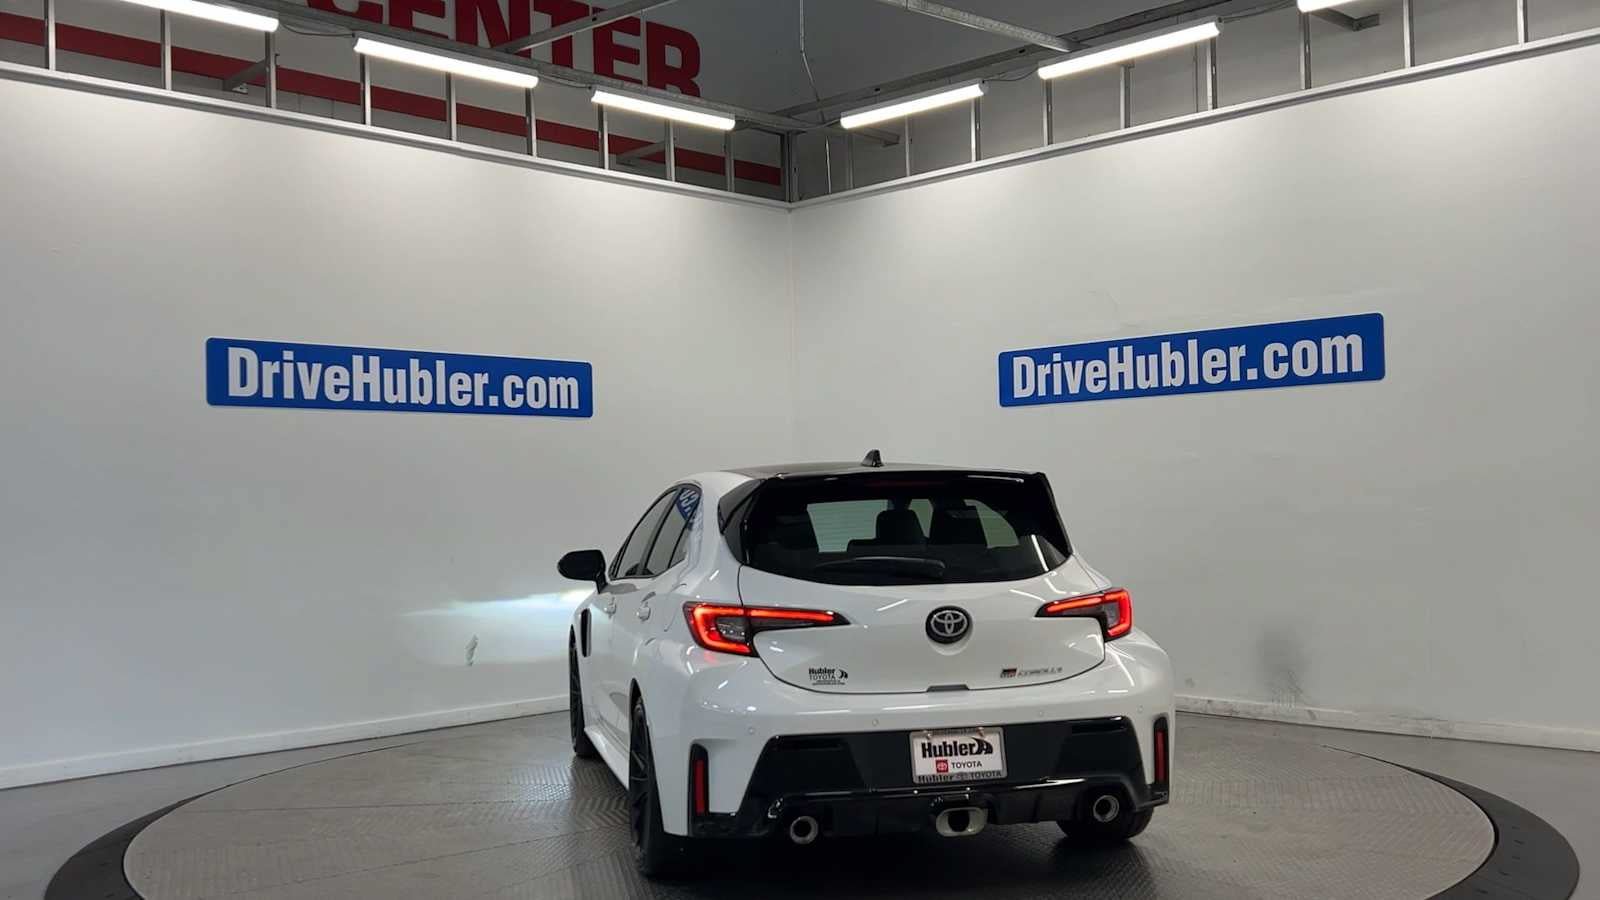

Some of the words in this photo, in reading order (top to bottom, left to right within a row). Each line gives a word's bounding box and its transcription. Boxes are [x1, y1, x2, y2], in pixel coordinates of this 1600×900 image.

[228, 346, 579, 410] DriveHubler.com
[1013, 333, 1364, 398] DriveHubler.com
[921, 740, 976, 758] Hubler
[952, 761, 982, 769] TOYOTA
